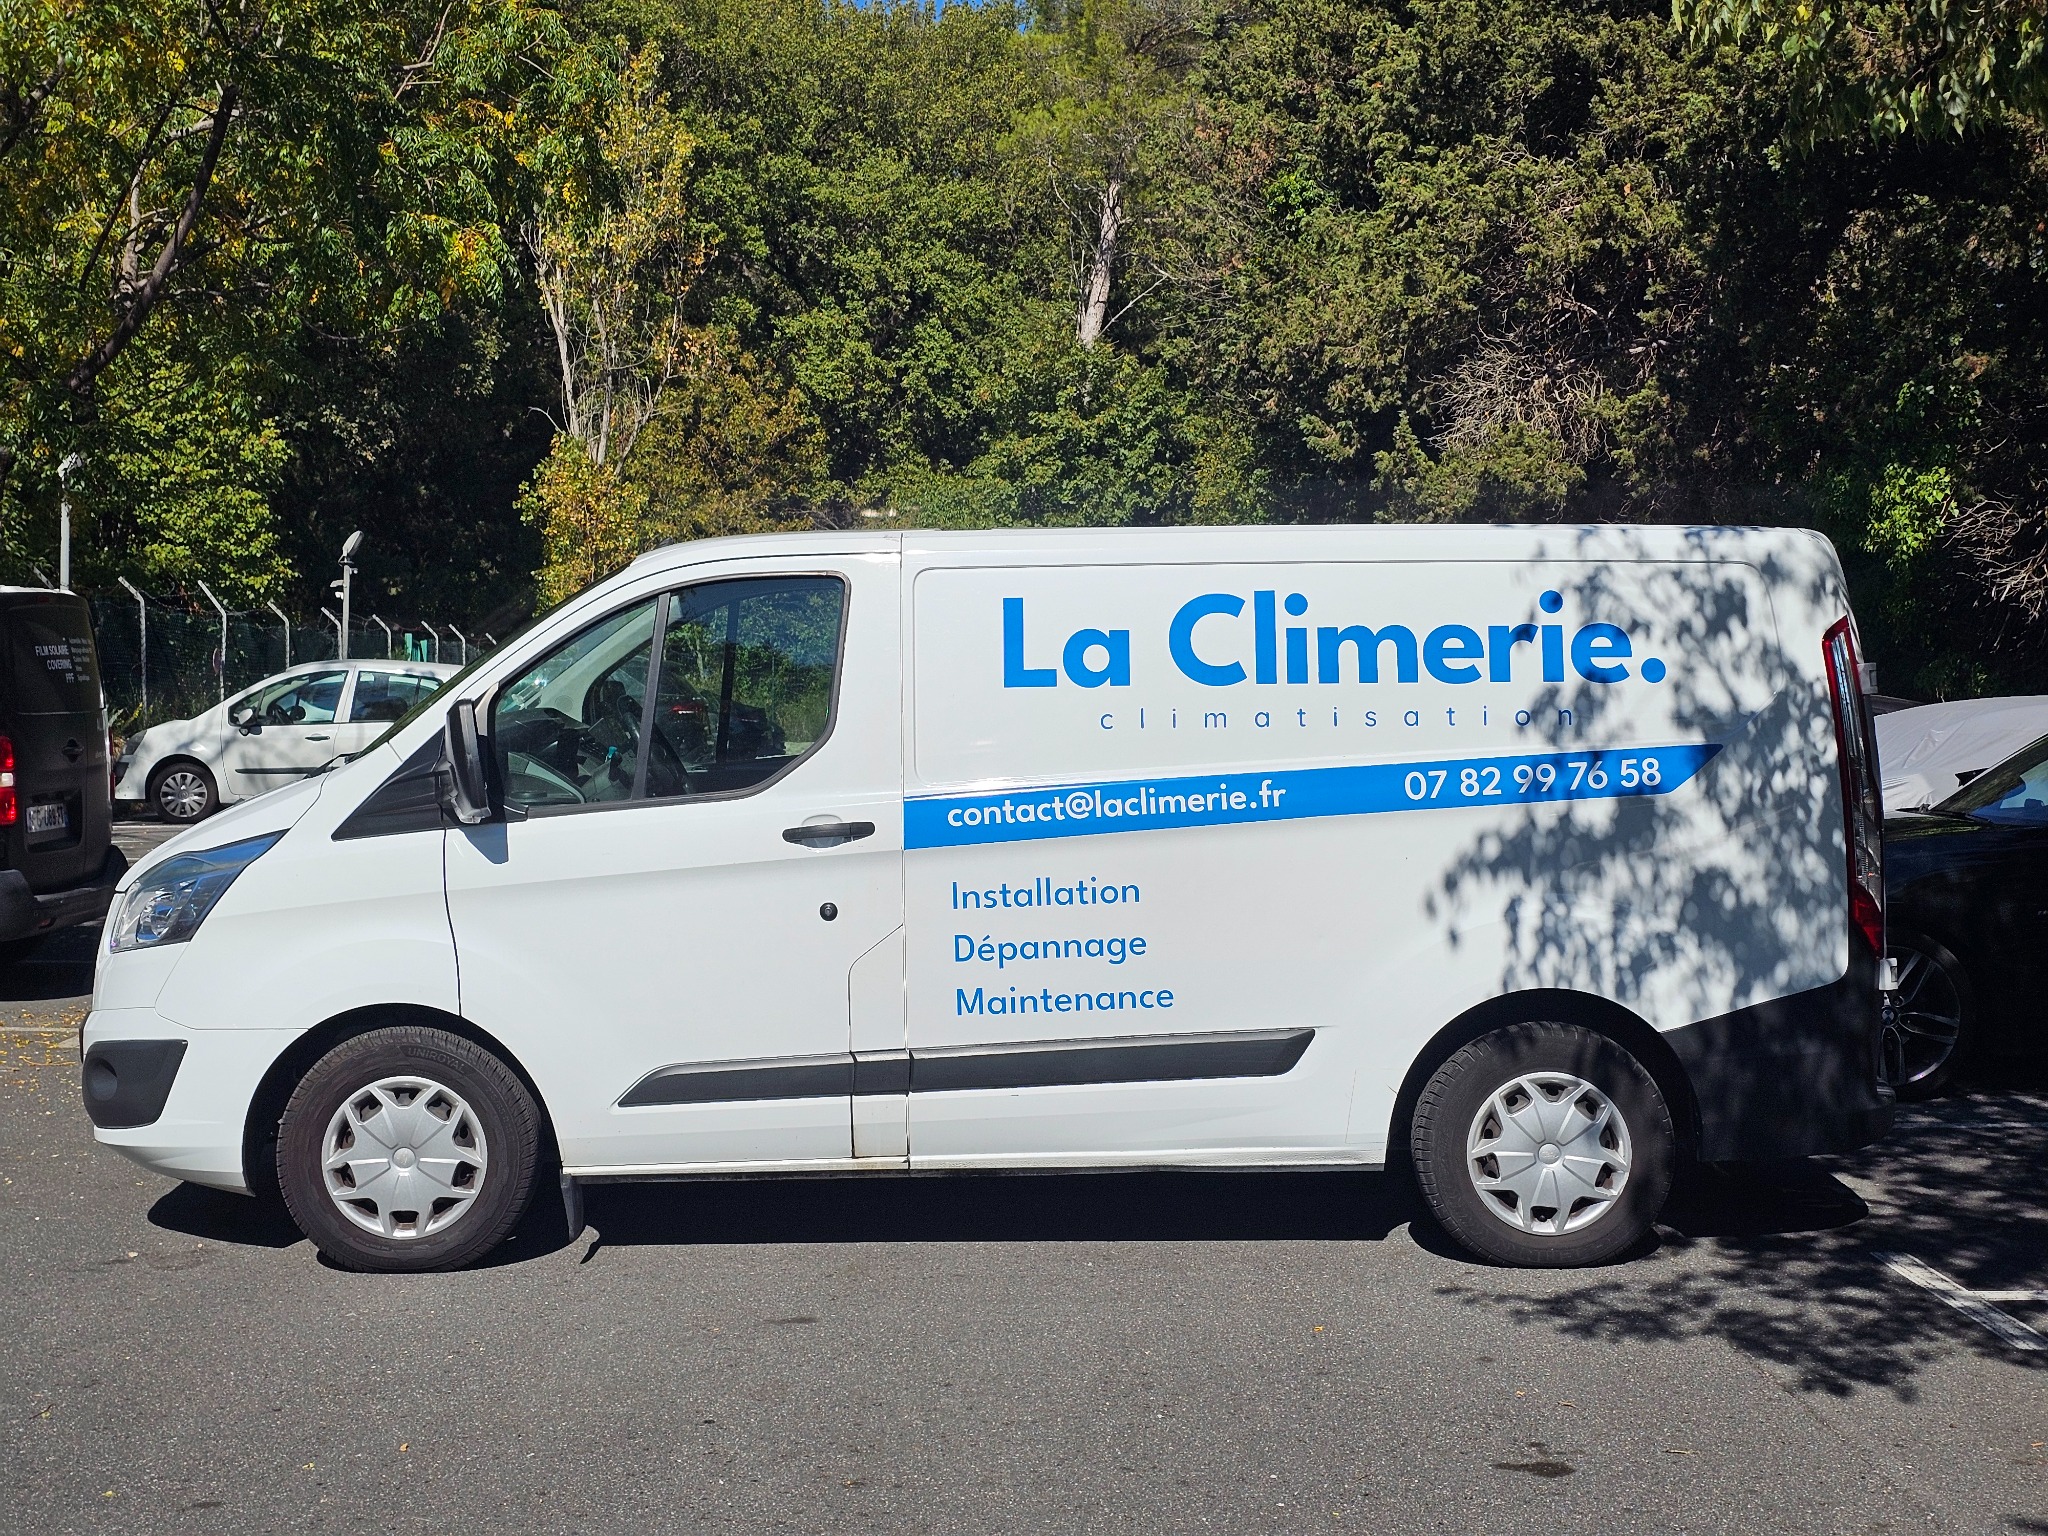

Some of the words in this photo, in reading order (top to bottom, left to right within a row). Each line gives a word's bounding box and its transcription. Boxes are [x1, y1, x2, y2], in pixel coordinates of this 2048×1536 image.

[35, 645, 49, 656] FILM
[1003, 597, 1130, 688] La
[1169, 590, 1668, 687] Climerie.
[47, 659, 72, 670] COVERING
[1100, 706, 1573, 730] climatisation
[1404, 770, 1447, 800] 07
[1460, 766, 1502, 797] 82
[1513, 763, 1556, 794] 99
[1568, 761, 1608, 790] 76
[1620, 757, 1662, 787] 58
[947, 780, 1287, 827] contact@laclimerie.fr
[952, 876, 1140, 910] Installation
[954, 934, 1147, 970] Dépannage
[957, 986, 1175, 1017] Maintenance
[408, 1047, 465, 1074] UNIROYAL
